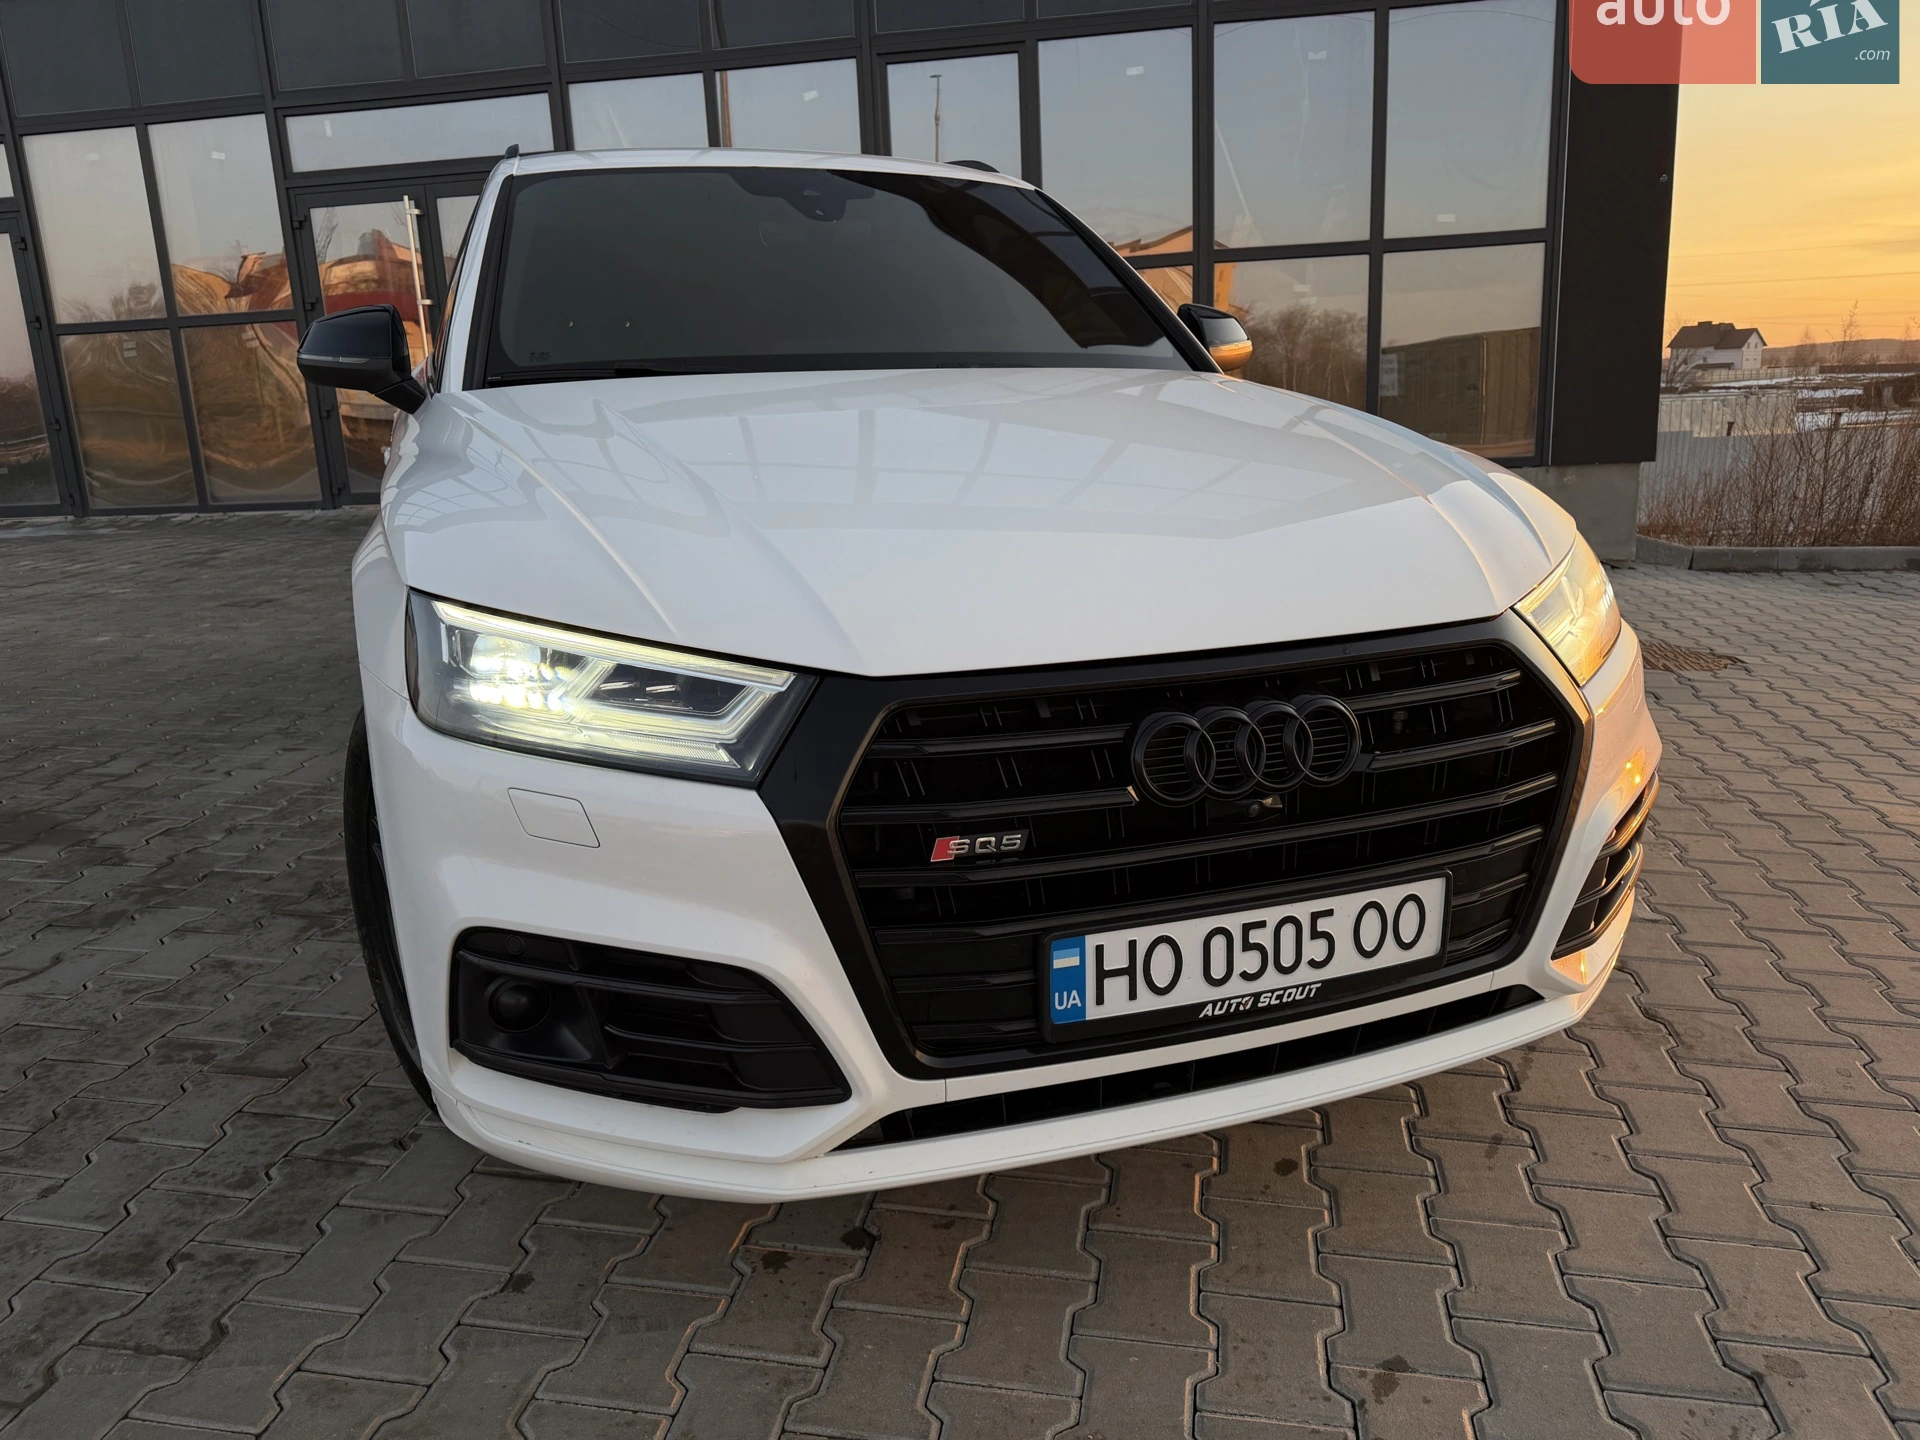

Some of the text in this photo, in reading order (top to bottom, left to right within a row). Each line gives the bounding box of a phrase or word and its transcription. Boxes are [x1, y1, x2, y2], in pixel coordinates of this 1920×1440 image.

[947, 834, 1022, 855] SQ5
[1095, 892, 1427, 1006] HO 0505 OO
[1054, 989, 1082, 1011] UA
[1199, 983, 1322, 1018] AUTO SCOUT
